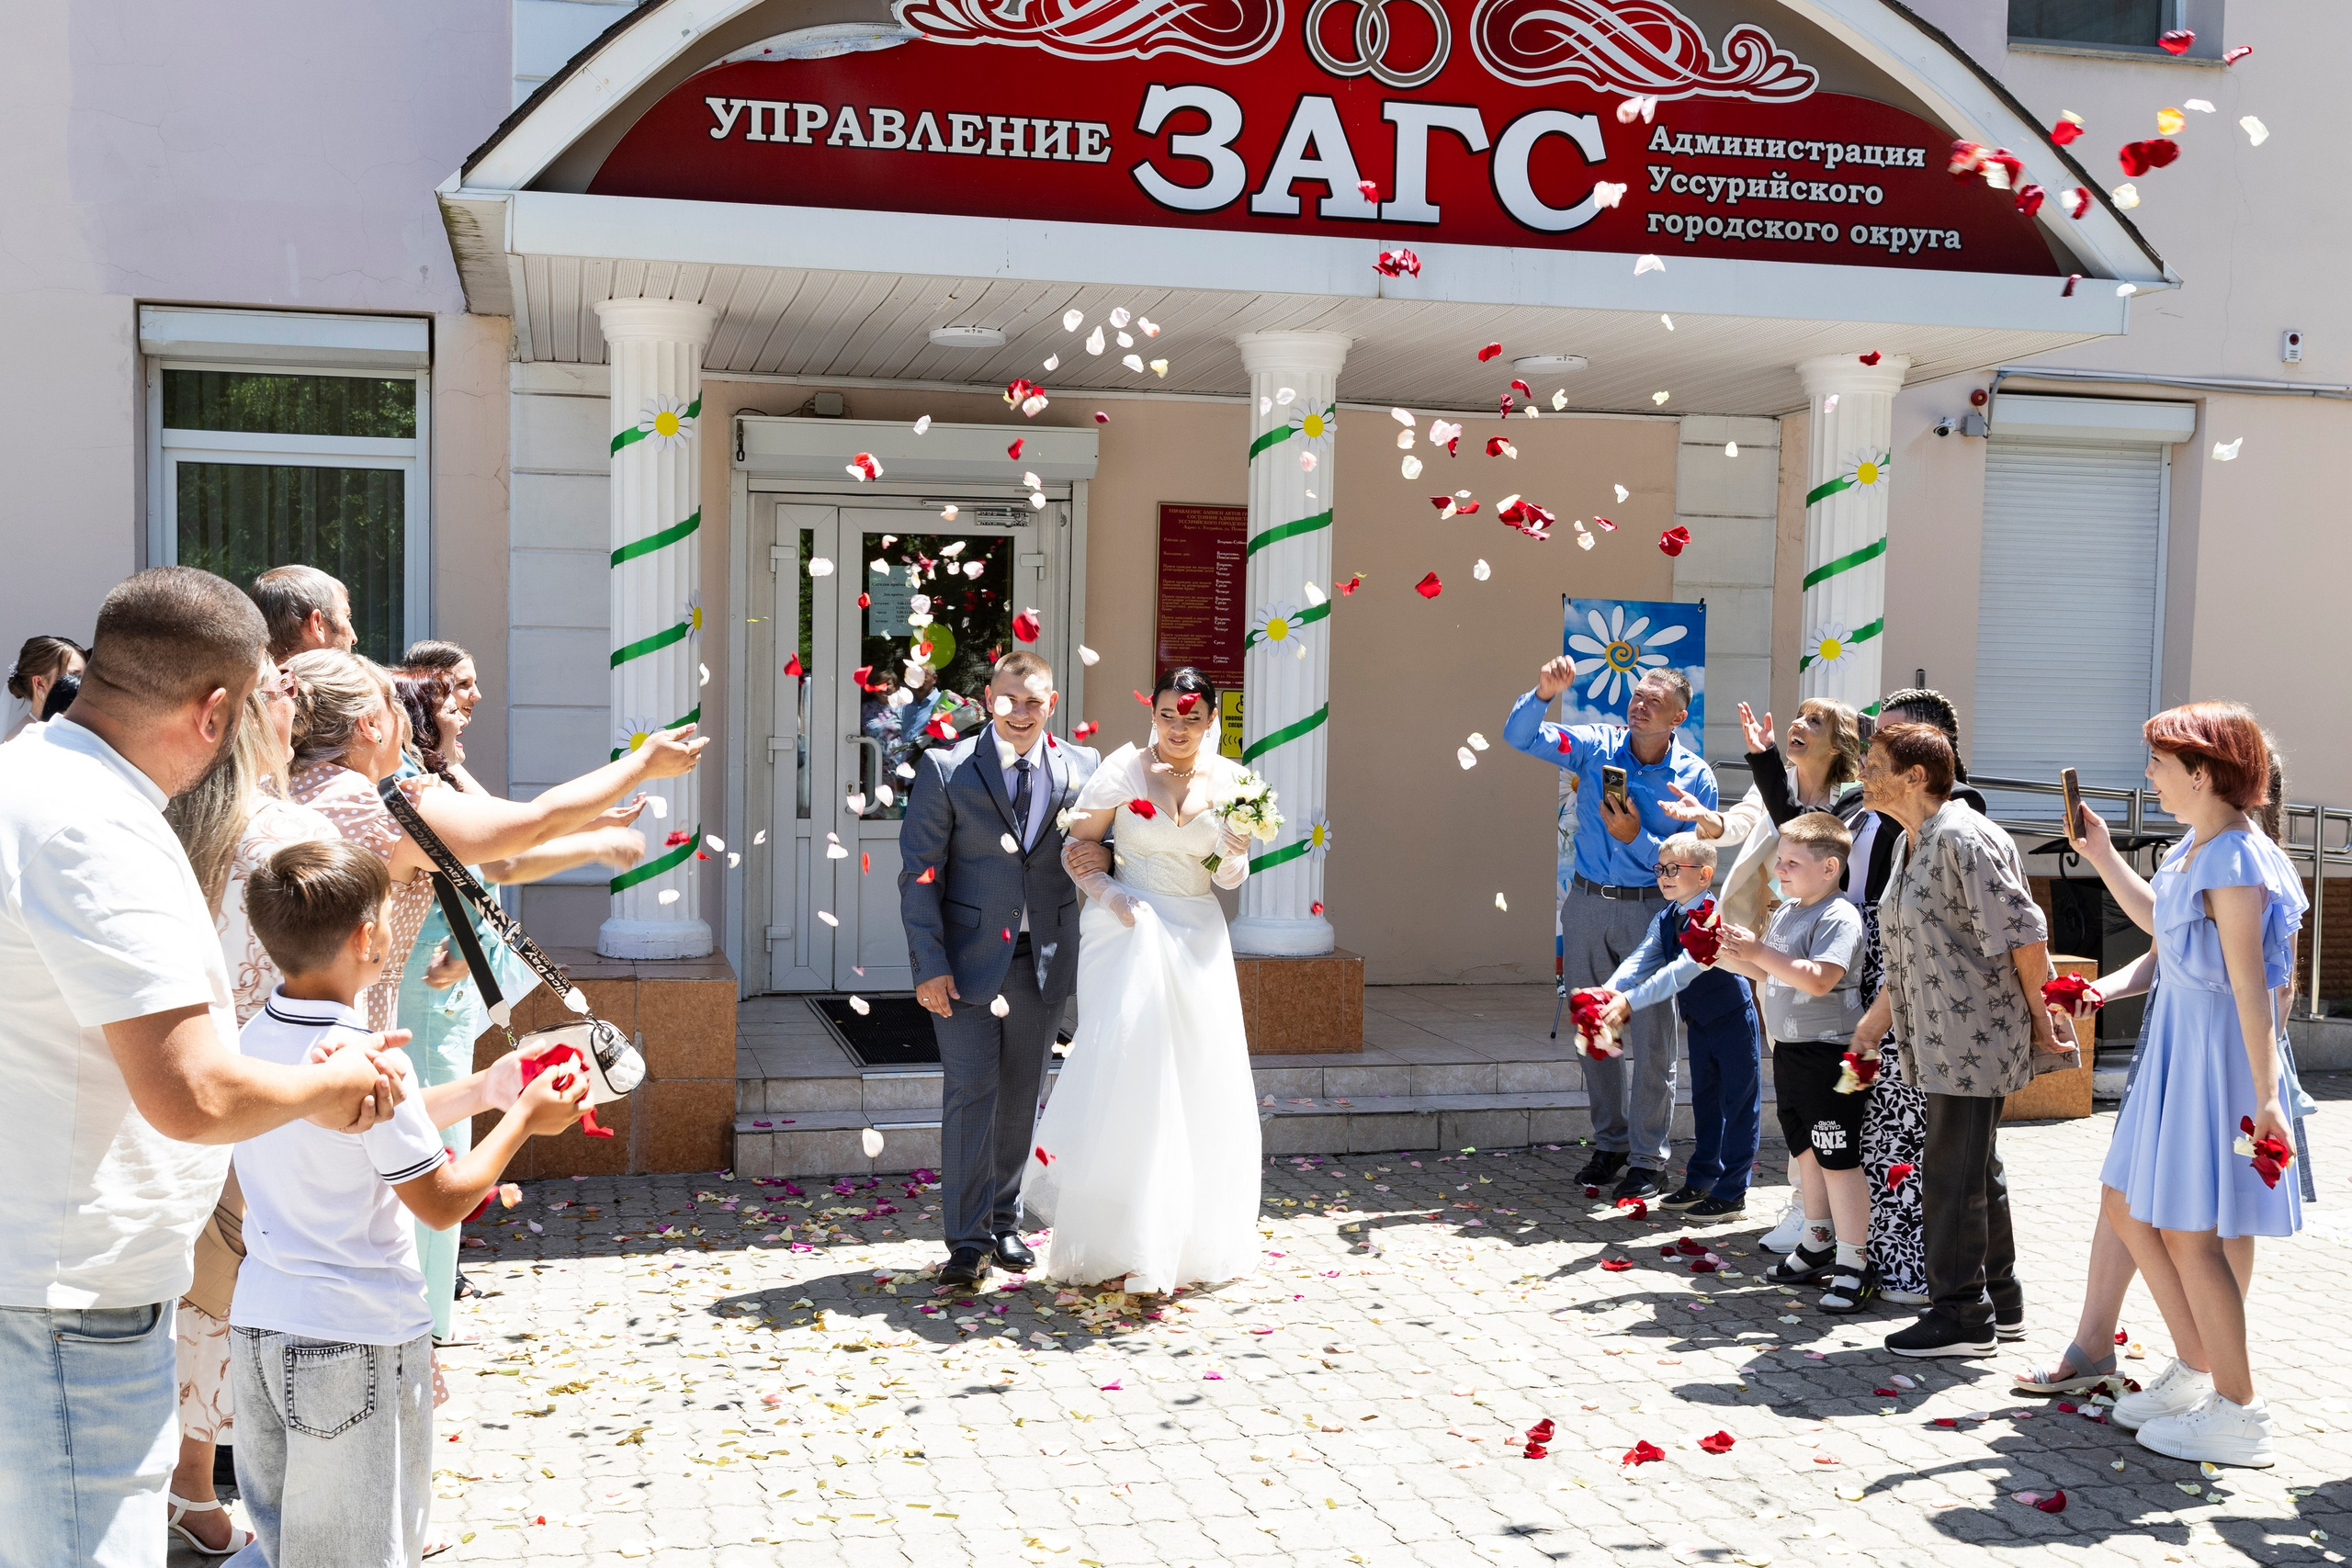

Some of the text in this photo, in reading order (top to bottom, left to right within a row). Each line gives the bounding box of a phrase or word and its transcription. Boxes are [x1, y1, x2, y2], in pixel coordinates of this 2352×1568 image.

[705, 84, 1607, 231] УПРАВЛЕНИЕ ЗАГС
[1648, 126, 1926, 168] Администрация
[1647, 166, 1884, 205] Уссурийского
[1647, 212, 1962, 254] городского округа
[389, 799, 413, 824] Day
[439, 858, 468, 886] Have
[525, 951, 548, 974] Day
[1811, 1130, 1847, 1149] ONE
